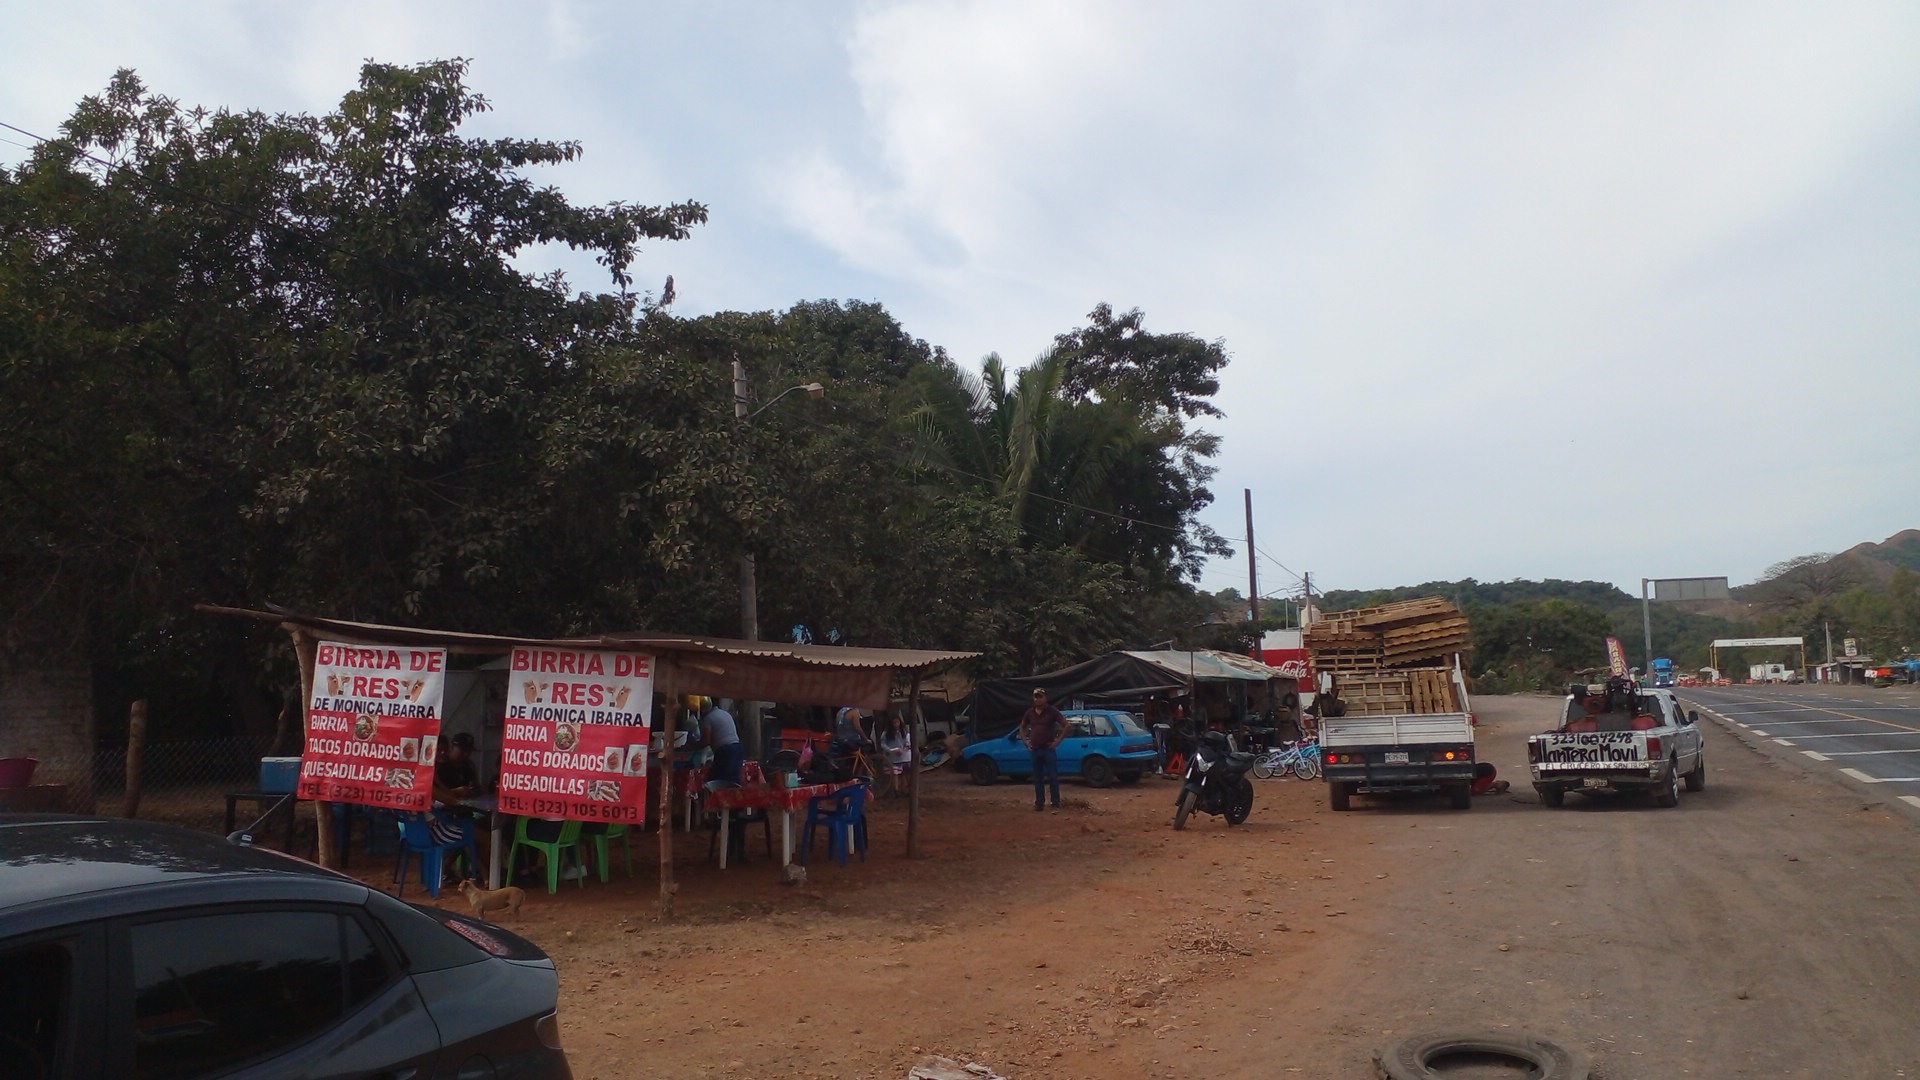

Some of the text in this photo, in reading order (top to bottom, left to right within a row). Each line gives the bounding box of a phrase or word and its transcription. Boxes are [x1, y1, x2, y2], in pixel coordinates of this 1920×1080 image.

[318, 645, 443, 673] BIRRIA DE
[512, 649, 650, 678] BIRRIA DE
[352, 676, 400, 699] RES
[551, 682, 605, 707] RES
[314, 697, 435, 719] DE MONICA IBARRA
[510, 705, 644, 727] DE MONICA IBARRA
[311, 715, 349, 732] BIRRIA
[506, 724, 548, 742] BIRRIA
[309, 738, 400, 761] TACOS DORADOS
[504, 748, 605, 772] TACOS DORADOS
[304, 761, 383, 782] QUESADILLAS
[502, 772, 585, 795] QUESADILLAS
[329, 784, 364, 801] (323)
[370, 789, 392, 803] 105
[396, 792, 425, 807] 6013
[502, 796, 638, 820] TEL: (323) 105 6013
